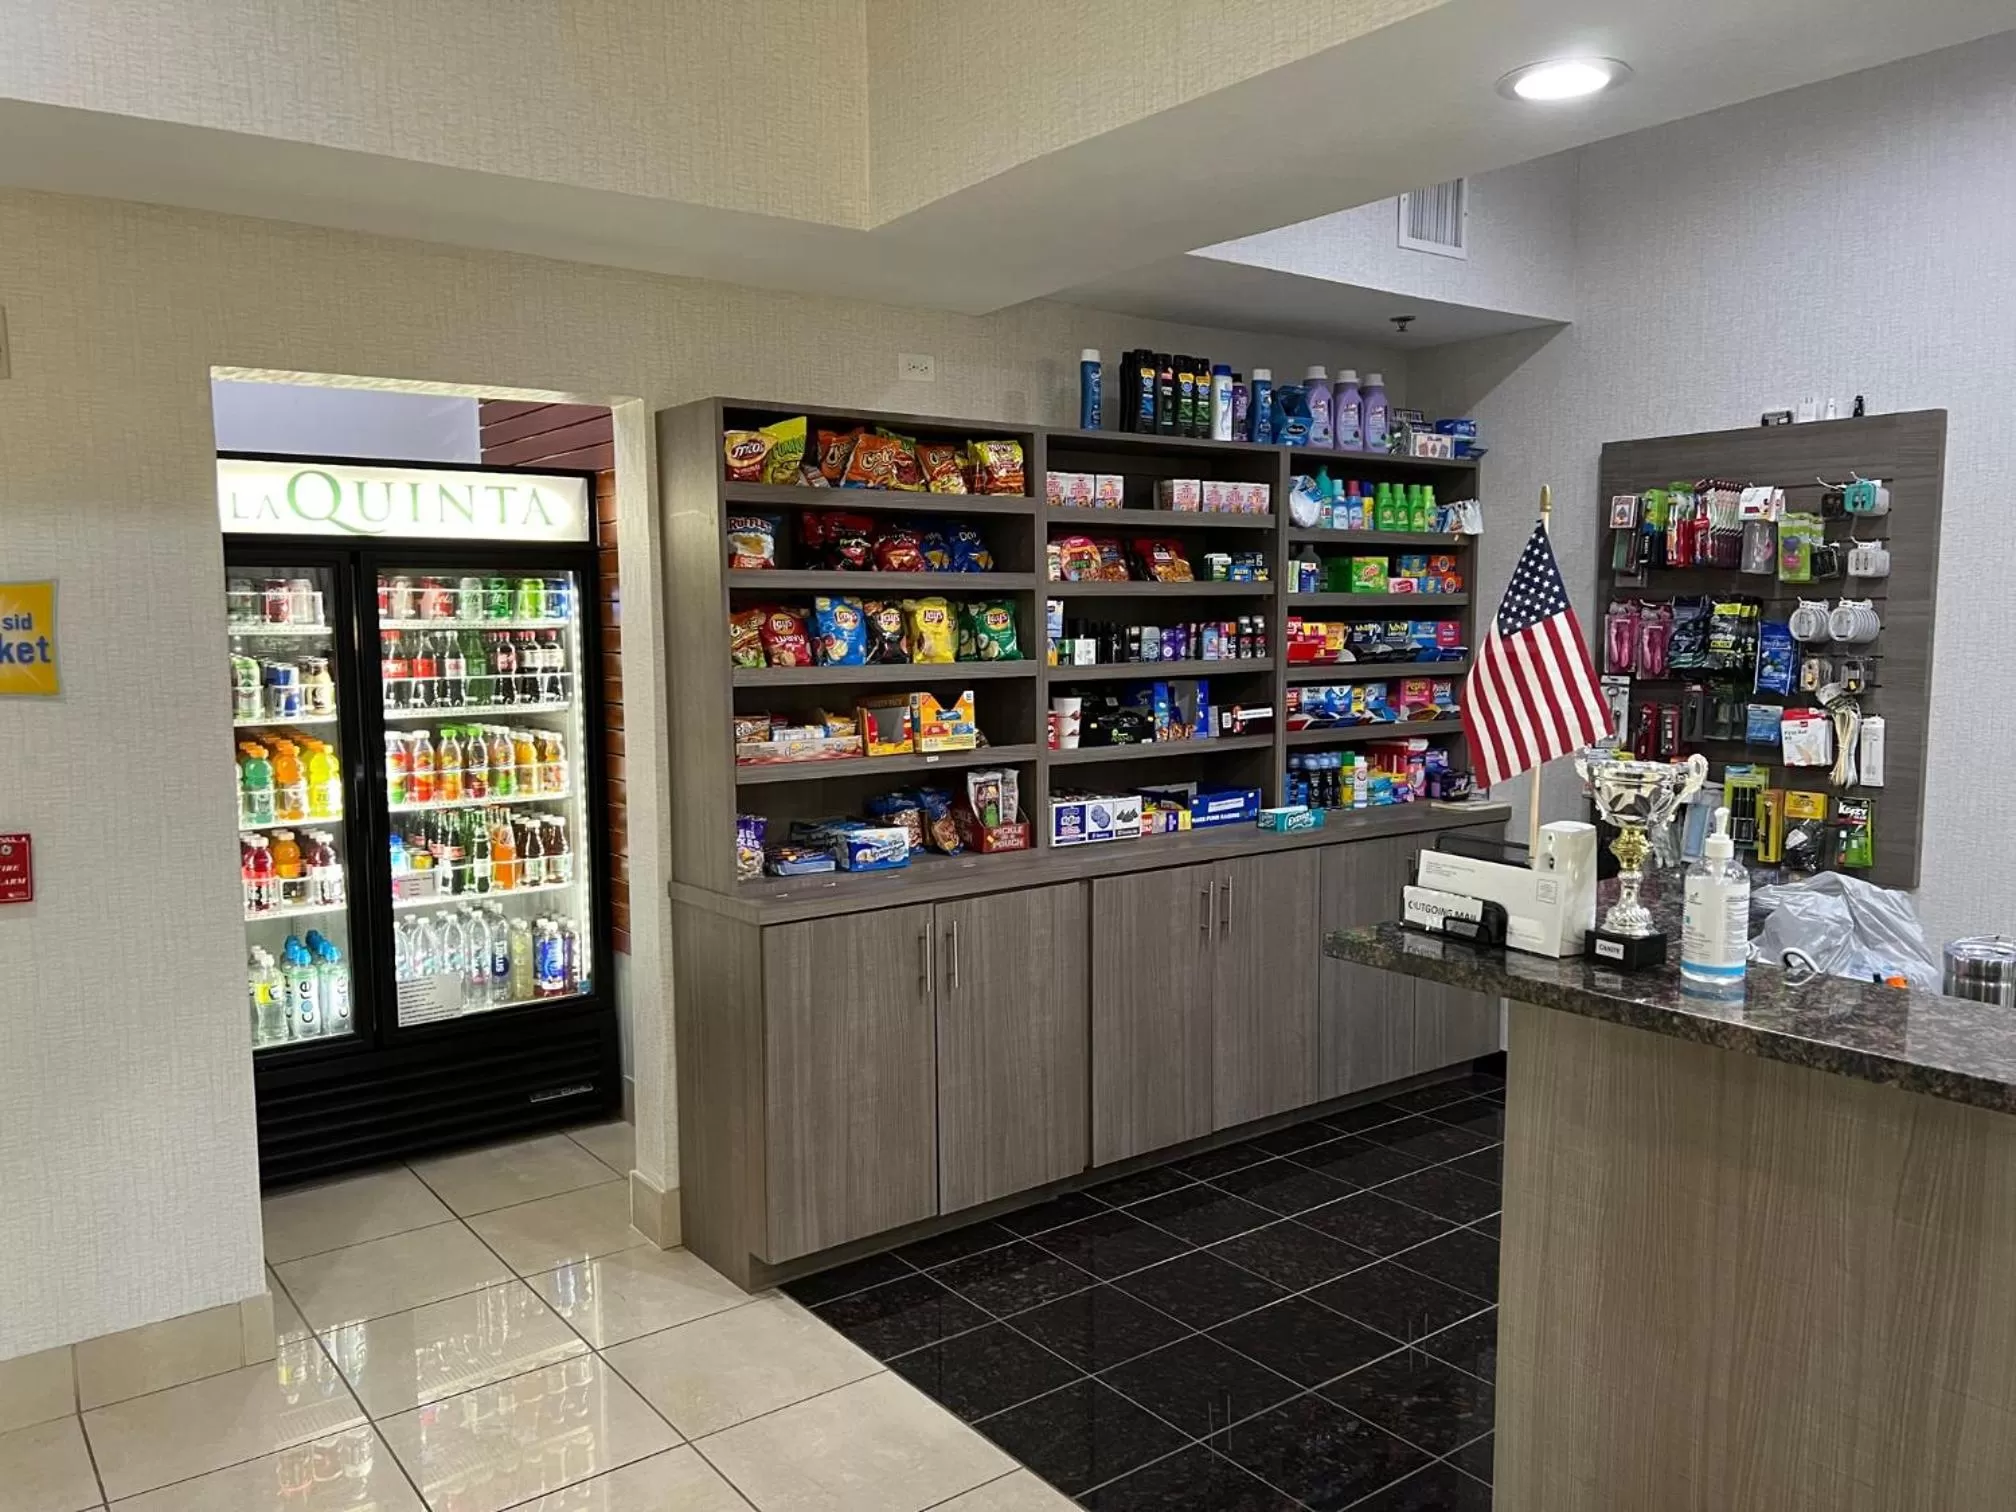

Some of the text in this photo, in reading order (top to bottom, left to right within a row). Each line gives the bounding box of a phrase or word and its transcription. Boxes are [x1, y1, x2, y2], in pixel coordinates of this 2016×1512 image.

[232, 469, 553, 533] LA QUINTA
[2, 612, 33, 631] sid
